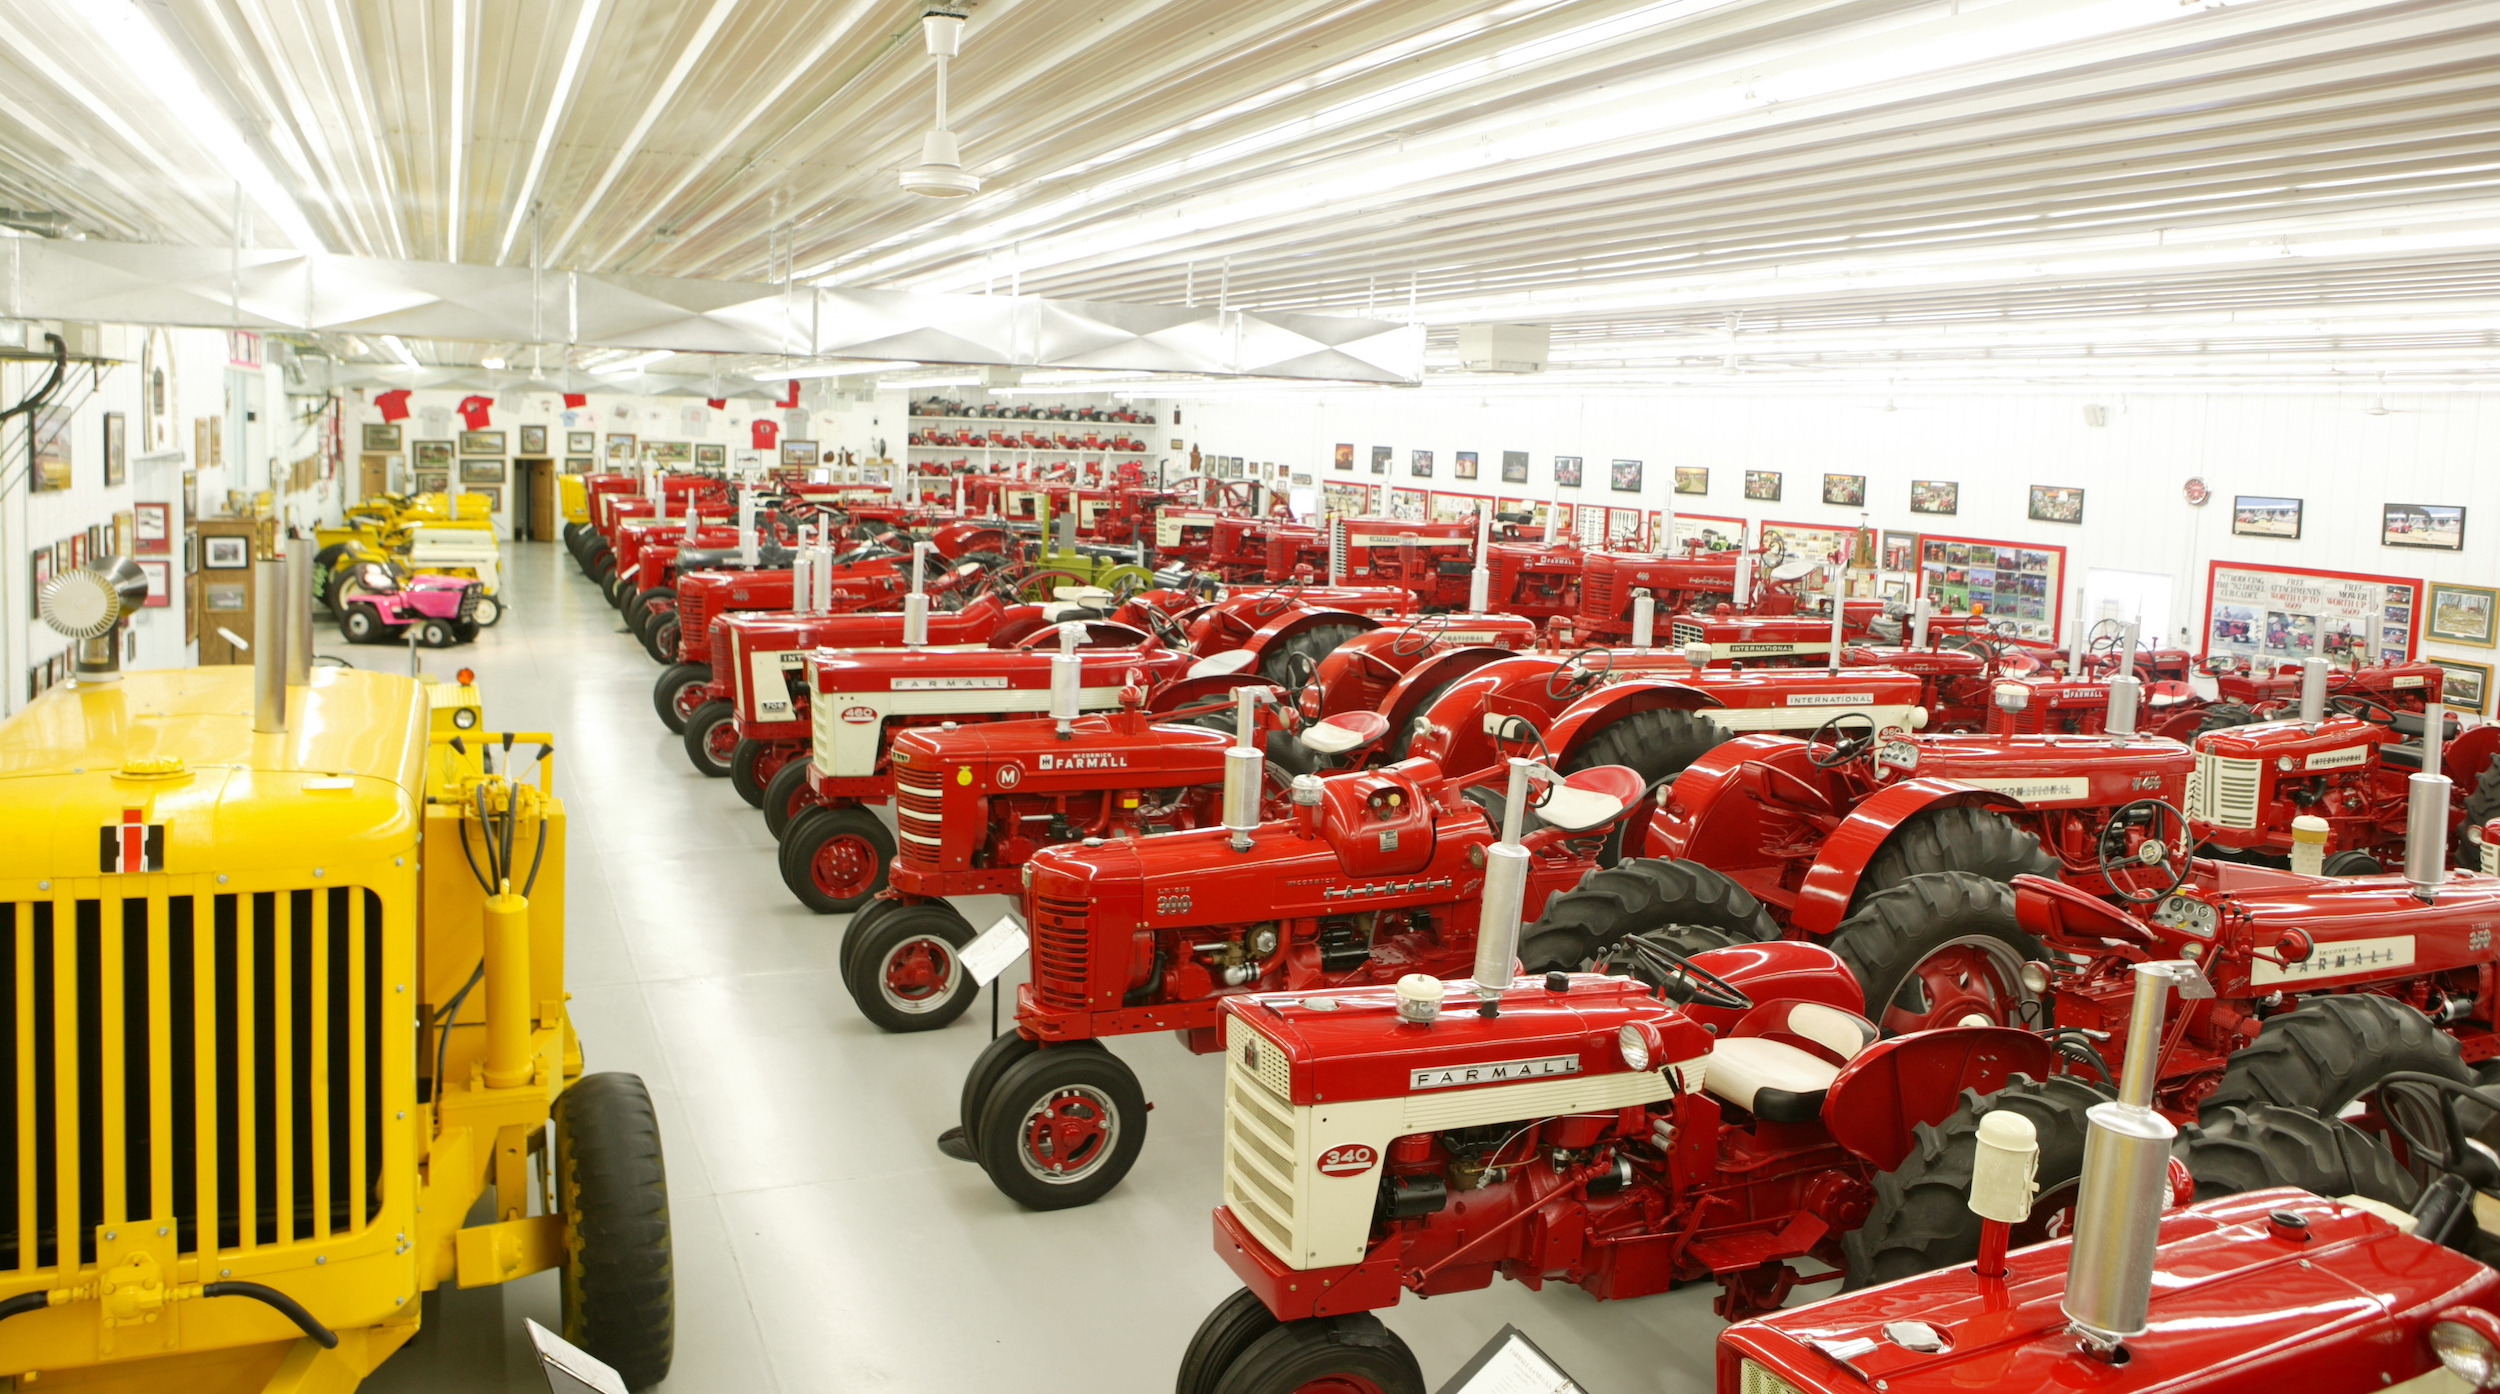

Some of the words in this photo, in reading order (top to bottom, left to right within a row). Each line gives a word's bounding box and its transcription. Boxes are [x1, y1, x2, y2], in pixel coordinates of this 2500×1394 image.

[1547, 558, 1575, 566] FARMALL
[2219, 573, 2265, 585] INTRODUCING
[2286, 578, 2305, 587] FREE
[2216, 581, 2229, 590] THE
[2242, 584, 2265, 593] DIESEL
[2270, 584, 2321, 596] ATTACHMENTS
[2344, 583, 2363, 591] FREE
[2220, 589, 2235, 598] CUB
[2270, 592, 2297, 602] WORTH
[2297, 595, 2308, 603] UP
[2309, 596, 2320, 604] TO
[2339, 591, 2368, 601] MOWER
[2284, 602, 2302, 610] $609
[2326, 597, 2354, 608] WORTH
[2355, 600, 2367, 609] UP
[895, 679, 1006, 688] FARMALL
[1790, 695, 1873, 704] INTERNATIONAL
[2070, 690, 2103, 699] FARMALL
[845, 708, 874, 717] 460
[1055, 757, 1128, 770] FARMALL
[2311, 753, 2362, 766] INTERNATIONAL
[1001, 770, 1015, 784] M
[1324, 875, 1452, 900] FARMALL
[1157, 895, 1193, 917] 300
[2468, 929, 2492, 951] 350
[2298, 948, 2393, 973] ARMALL
[1417, 1060, 1576, 1086] FARMALL
[1326, 1148, 1371, 1165] 340
